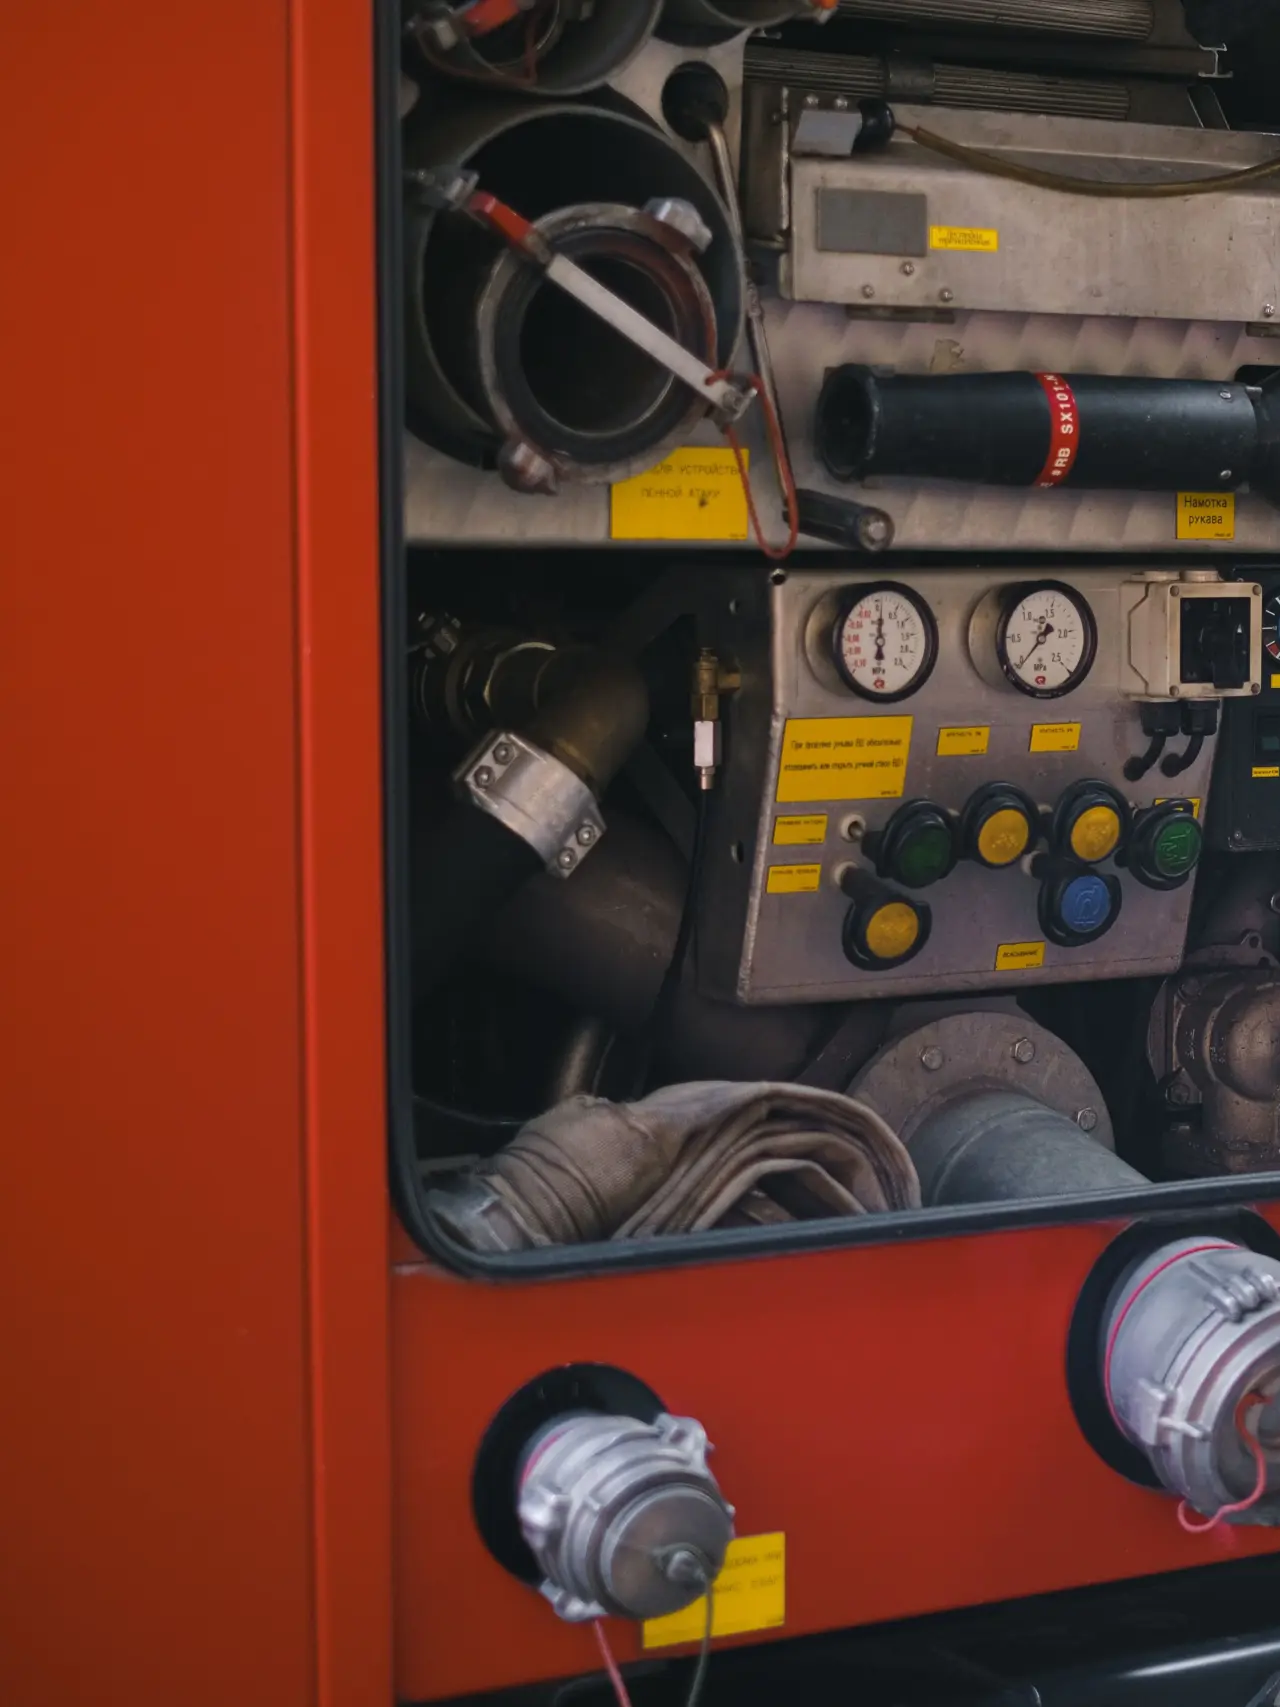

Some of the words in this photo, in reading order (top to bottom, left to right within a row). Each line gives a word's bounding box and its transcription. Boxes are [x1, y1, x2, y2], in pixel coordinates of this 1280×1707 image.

[1184, 495, 1228, 508] Намотка
[1188, 515, 1223, 528] рукава
[1022, 611, 1032, 621] 1.0
[1045, 609, 1055, 618] 1.5
[1011, 634, 1021, 643] 0.5
[1058, 629, 1068, 639] 2.0
[1051, 652, 1062, 662] 2.5
